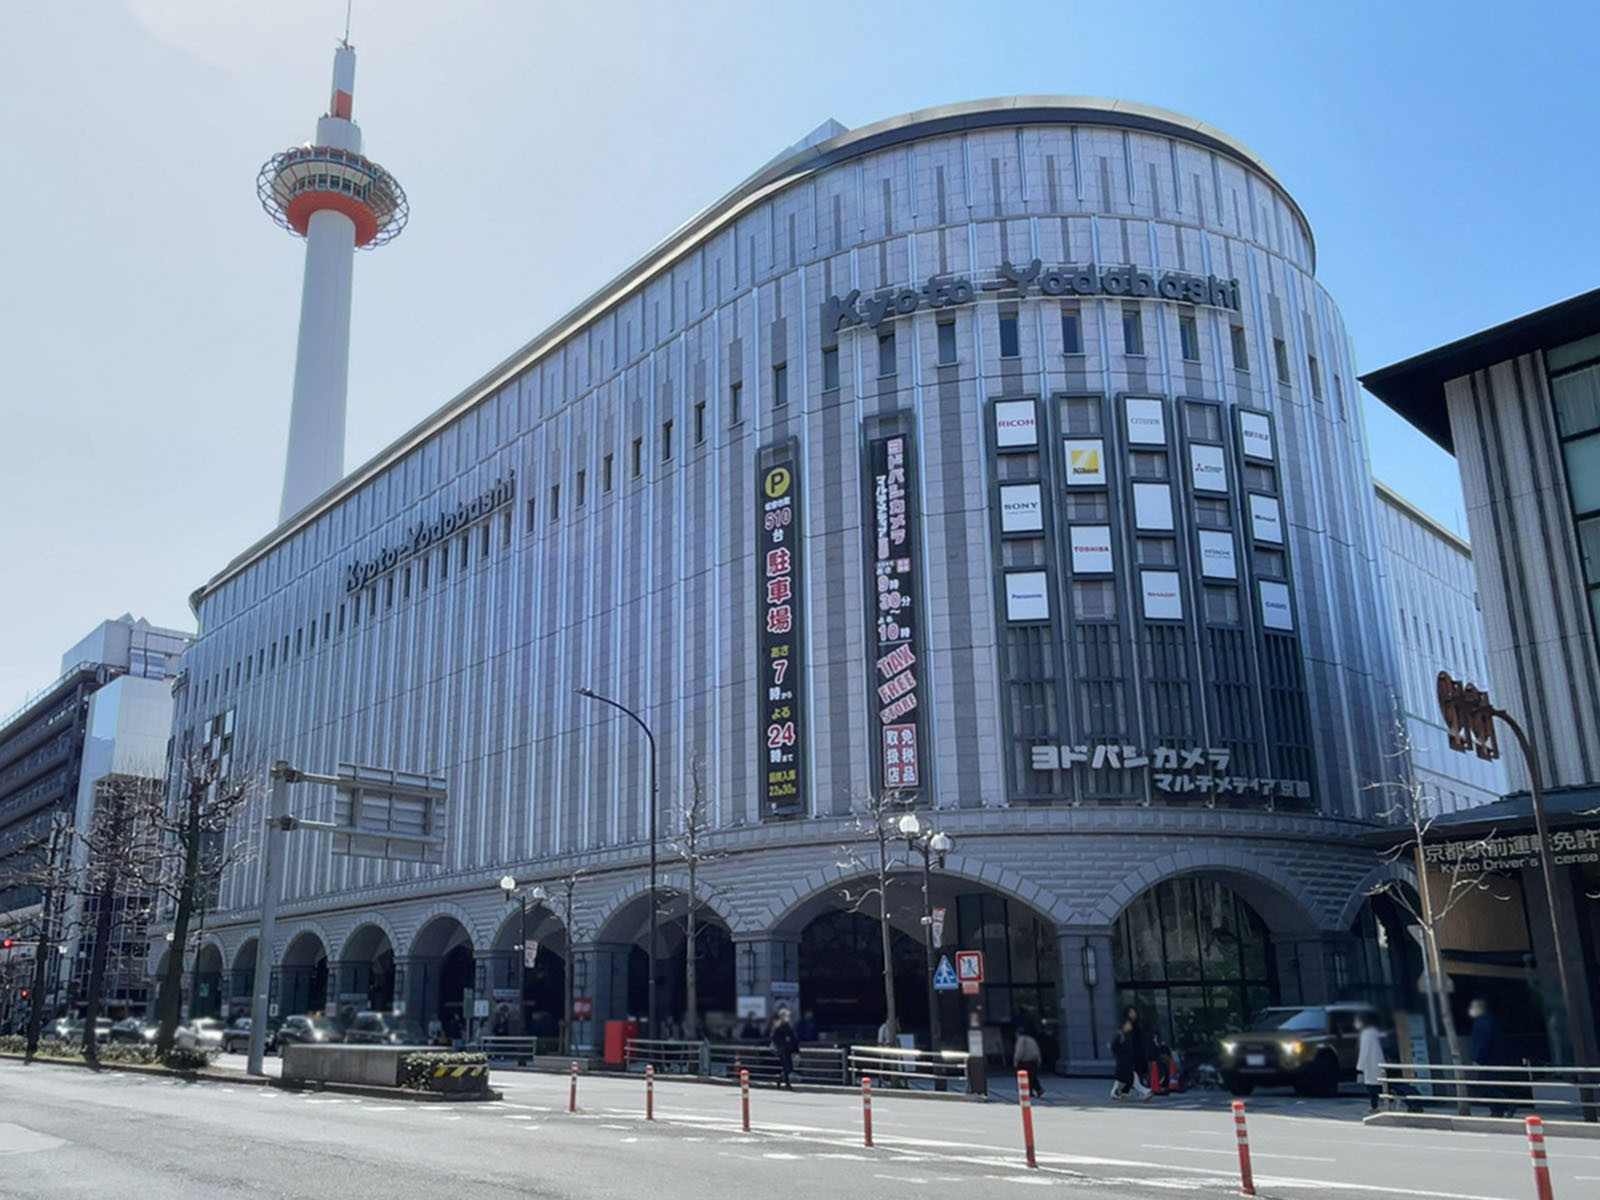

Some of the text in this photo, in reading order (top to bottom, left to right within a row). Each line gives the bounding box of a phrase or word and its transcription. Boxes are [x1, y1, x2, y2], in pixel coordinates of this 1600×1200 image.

[998, 419, 1034, 428] RICOH
[771, 472, 784, 493] P
[887, 438, 906, 545] ヨドバシカメラ
[876, 475, 889, 559] マルチメディア
[1004, 502, 1038, 510] SONY
[772, 528, 784, 542] 台
[767, 547, 792, 633] 駐車場
[772, 659, 788, 684] 7
[877, 643, 916, 679] TAX
[877, 670, 917, 704] FREE
[879, 692, 917, 724] STORE
[768, 721, 796, 748] 24
[1032, 744, 1231, 770] ヨドバシカメラ
[769, 769, 796, 783] 入場
[1441, 853, 1598, 874] Kyoto Driver's cense
